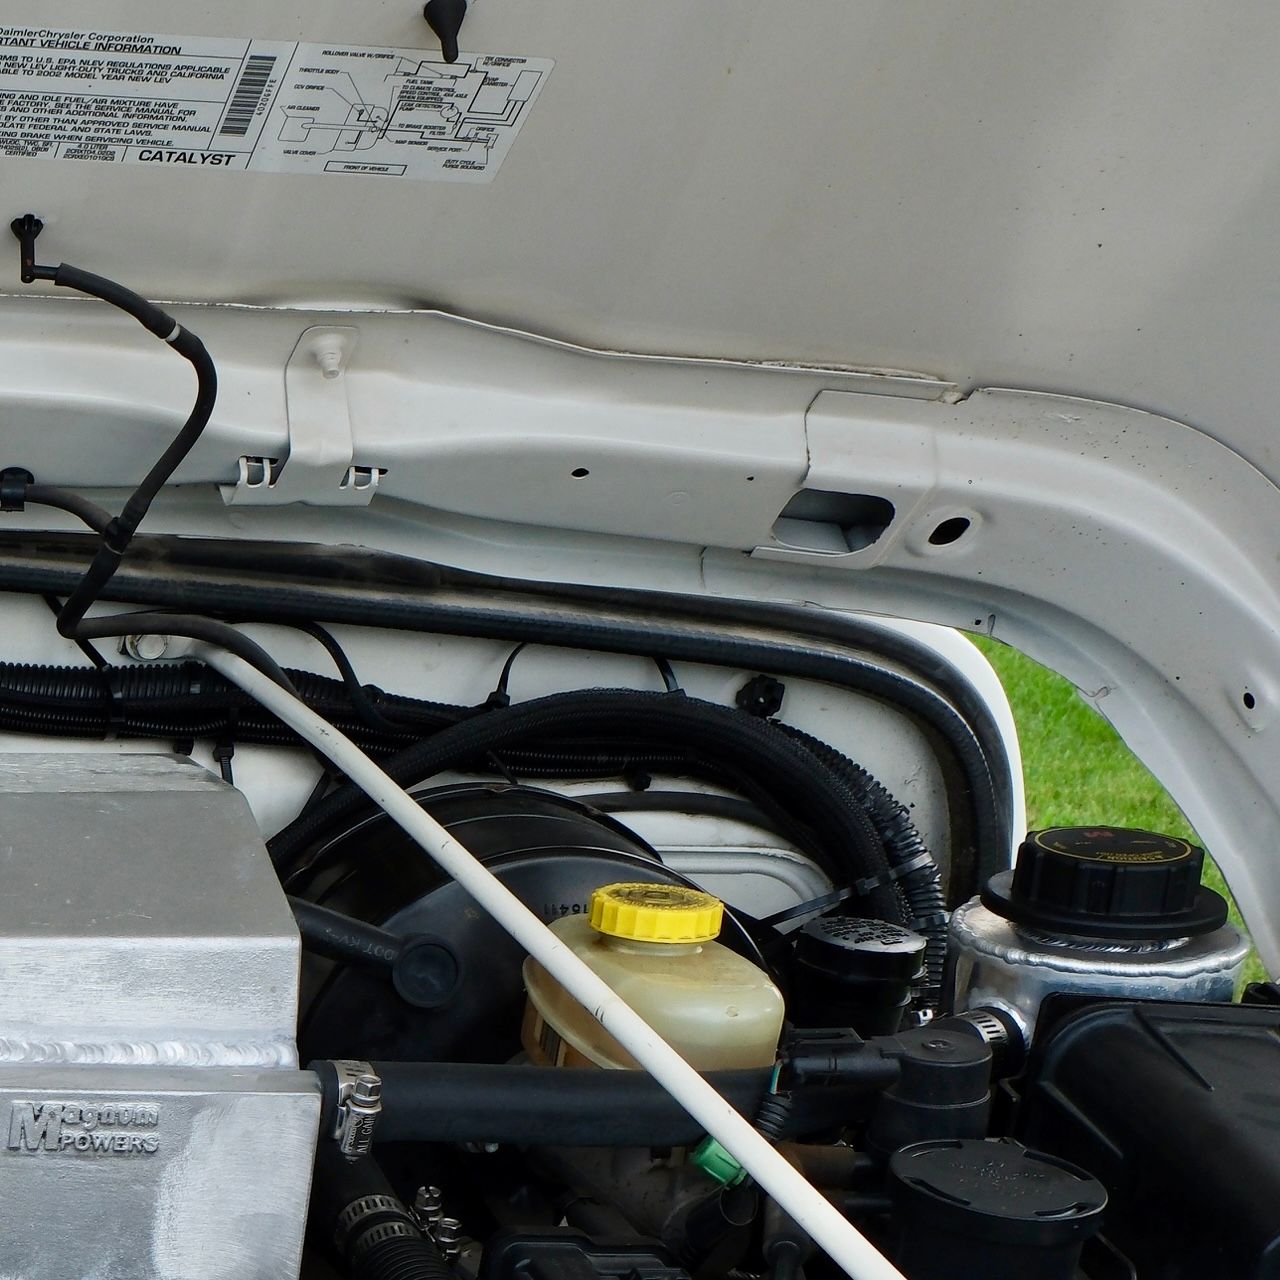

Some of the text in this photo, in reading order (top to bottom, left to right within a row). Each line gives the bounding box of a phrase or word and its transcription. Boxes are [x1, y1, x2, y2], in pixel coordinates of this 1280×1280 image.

[89, 31, 154, 45] Corporation
[40, 39, 90, 49] VEHICLE
[94, 42, 181, 54] INFORMATION
[49, 64, 102, 73] LIGHT-DUTY
[106, 67, 143, 75] TRUCKS
[170, 71, 224, 79] CALIFORNIA
[106, 60, 170, 70] REGULATIONS
[174, 64, 229, 73] APPLICABLE
[65, 71, 97, 79] MODEL
[101, 73, 125, 81] YEAR
[18, 93, 37, 101] AND
[64, 96, 106, 104] FUEL/AIR
[110, 98, 151, 107] MIXTURE
[32, 107, 62, 115] OTHER
[65, 109, 119, 118] ADDITIONAL
[94, 104, 131, 113] SERVICE
[135, 107, 174, 115] MANUAL
[28, 123, 67, 132] FEDERAL
[80, 119, 128, 128] APPROVED
[131, 122, 169, 130] SERVICE
[171, 124, 210, 132] MANUAL
[85, 135, 132, 144] SERVICING
[136, 138, 173, 146] VEHICLE.
[138, 149, 235, 165] CATALYST
[61, 1132, 160, 1153] POWERS
